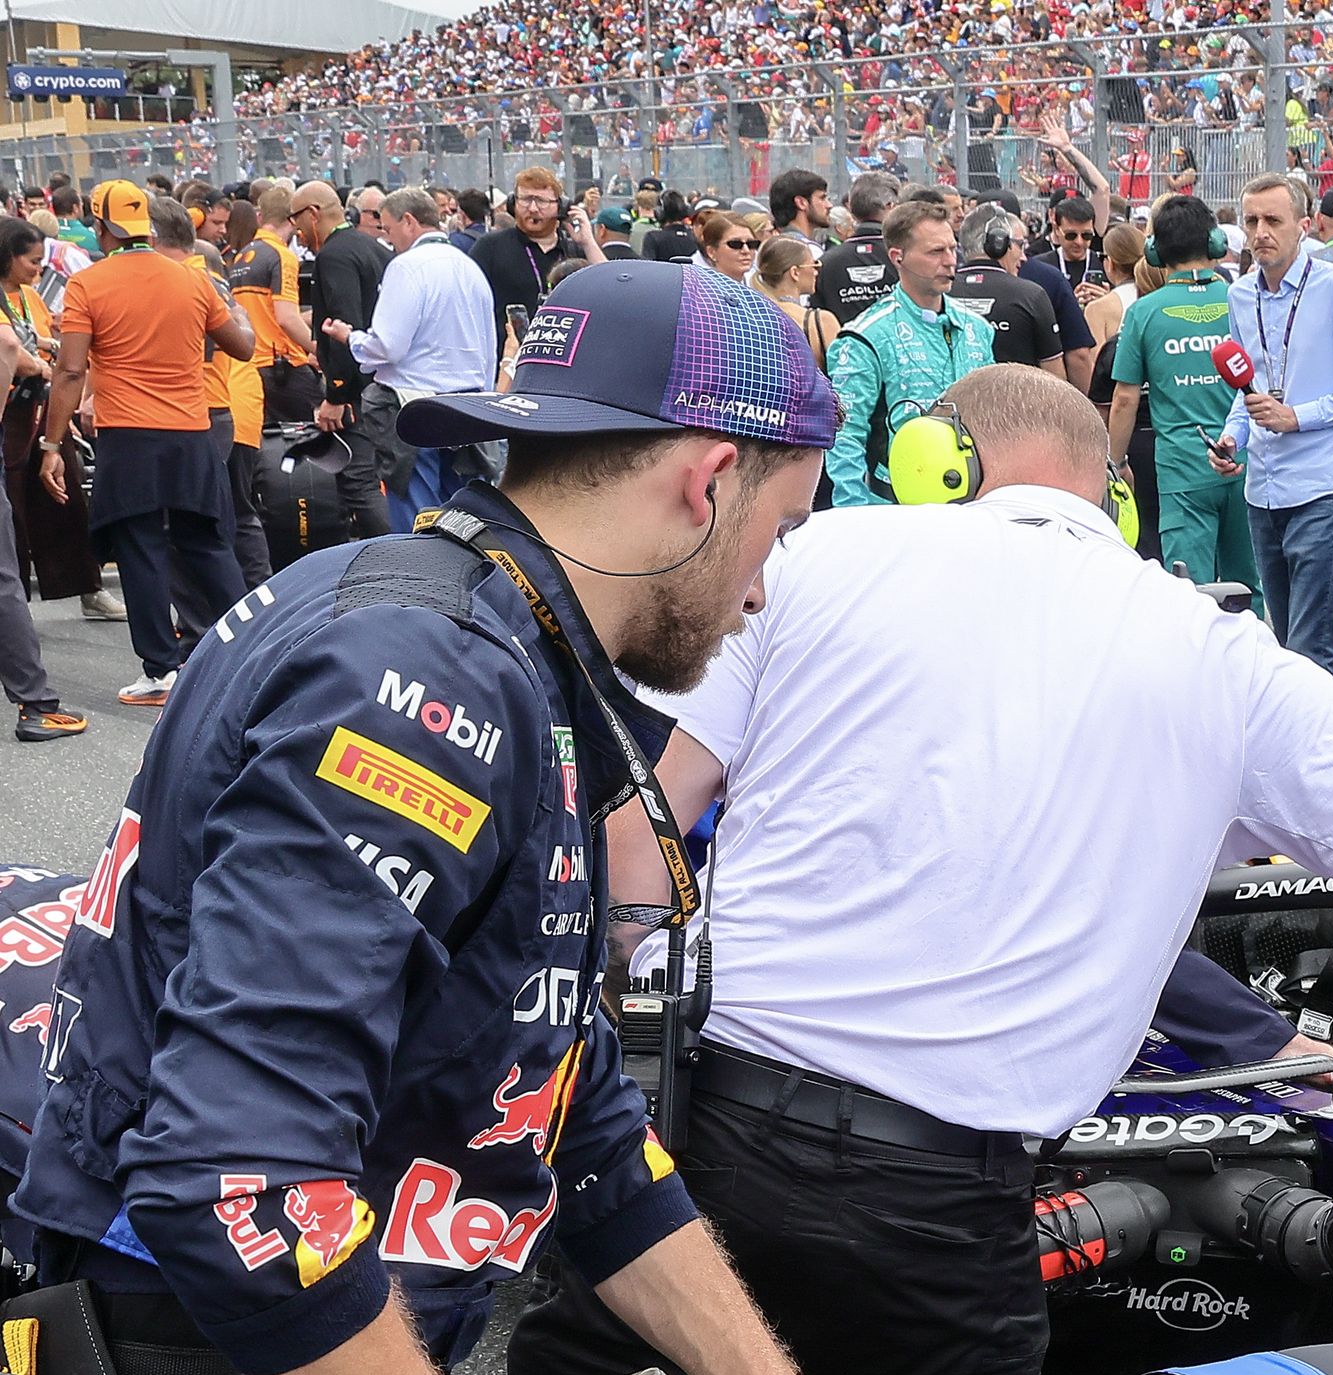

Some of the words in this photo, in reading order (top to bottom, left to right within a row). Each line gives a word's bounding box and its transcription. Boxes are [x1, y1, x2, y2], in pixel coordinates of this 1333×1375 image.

[34, 75, 121, 89] crypto.com
[839, 285, 897, 298] CADILLAC
[1188, 285, 1207, 293] BOSS
[519, 346, 564, 356] ACING
[1164, 333, 1232, 355] aram
[1190, 374, 1223, 385] Hon
[1226, 352, 1249, 378] E
[674, 391, 787, 427] ALPHATAURI
[496, 552, 521, 584] TIME
[522, 573, 541, 601] ALL
[377, 669, 503, 766] Mobil
[333, 744, 473, 836] PIRELLI
[663, 838, 681, 871] TIME
[344, 832, 435, 915] VISA
[675, 866, 691, 889] ALL
[1070, 1114, 1225, 1145] Gate
[378, 1157, 561, 1273] Red
[213, 1188, 291, 1272] Bull
[1172, 1251, 1185, 1260] FR
[1127, 1287, 1186, 1312] Hard
[1190, 1291, 1251, 1321] Rock
